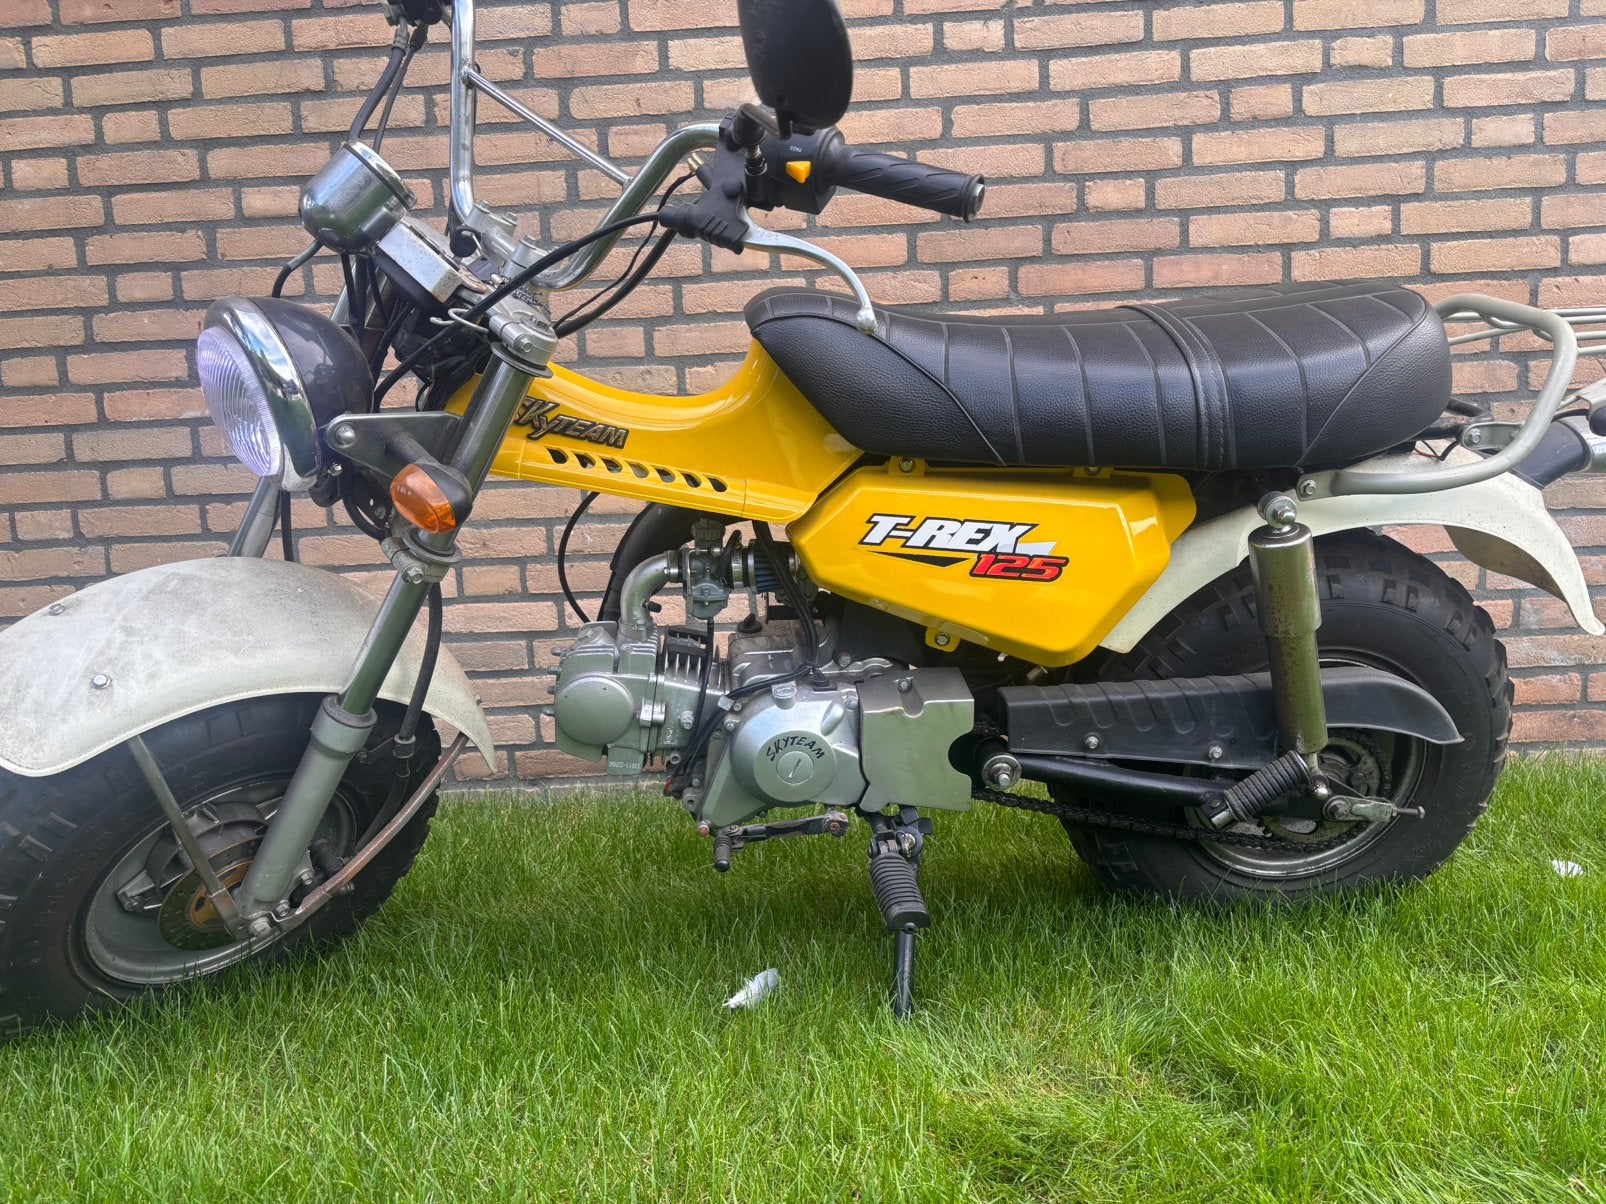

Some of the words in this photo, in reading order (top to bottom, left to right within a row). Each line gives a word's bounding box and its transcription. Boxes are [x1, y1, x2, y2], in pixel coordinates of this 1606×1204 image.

[858, 513, 1039, 554] T-REX
[969, 552, 1069, 582] 125
[766, 736, 826, 762] SKYTEAM
